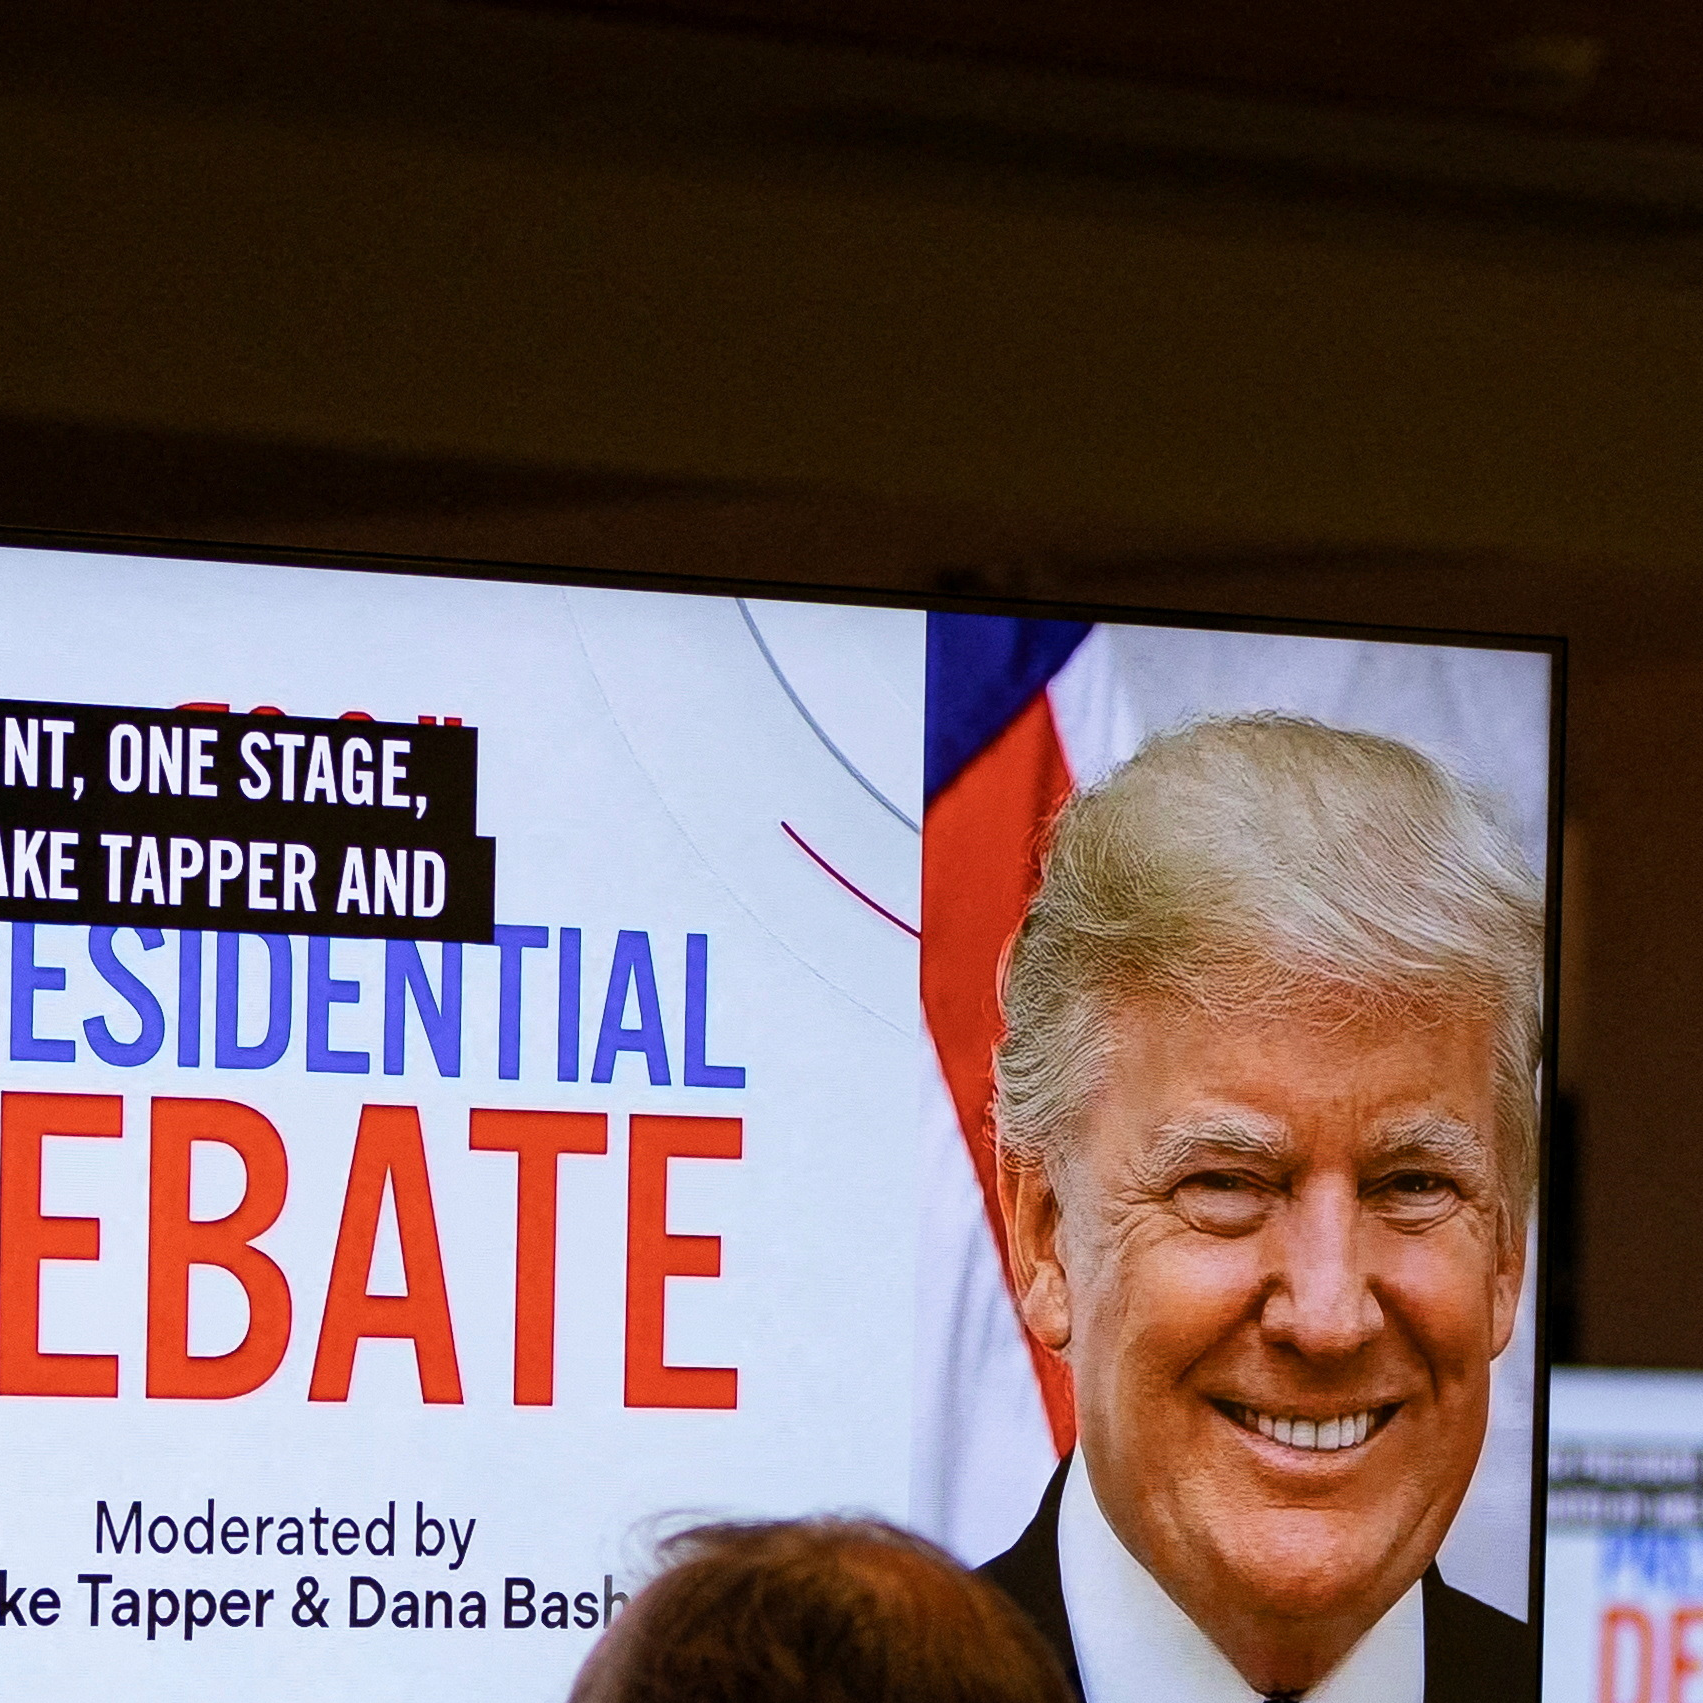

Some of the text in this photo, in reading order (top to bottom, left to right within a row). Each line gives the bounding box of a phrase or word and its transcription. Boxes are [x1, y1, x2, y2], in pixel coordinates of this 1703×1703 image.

[109, 723, 218, 797] ONE
[239, 731, 428, 820] STAGE,
[100, 833, 317, 912] TAPPER
[336, 846, 446, 918] AND
[96, 1498, 477, 1571] Moderated by
[77, 1573, 275, 1641] Tapper
[291, 1575, 330, 1628] &
[349, 1575, 487, 1629] Dana
[503, 1574, 631, 1630] Bash
